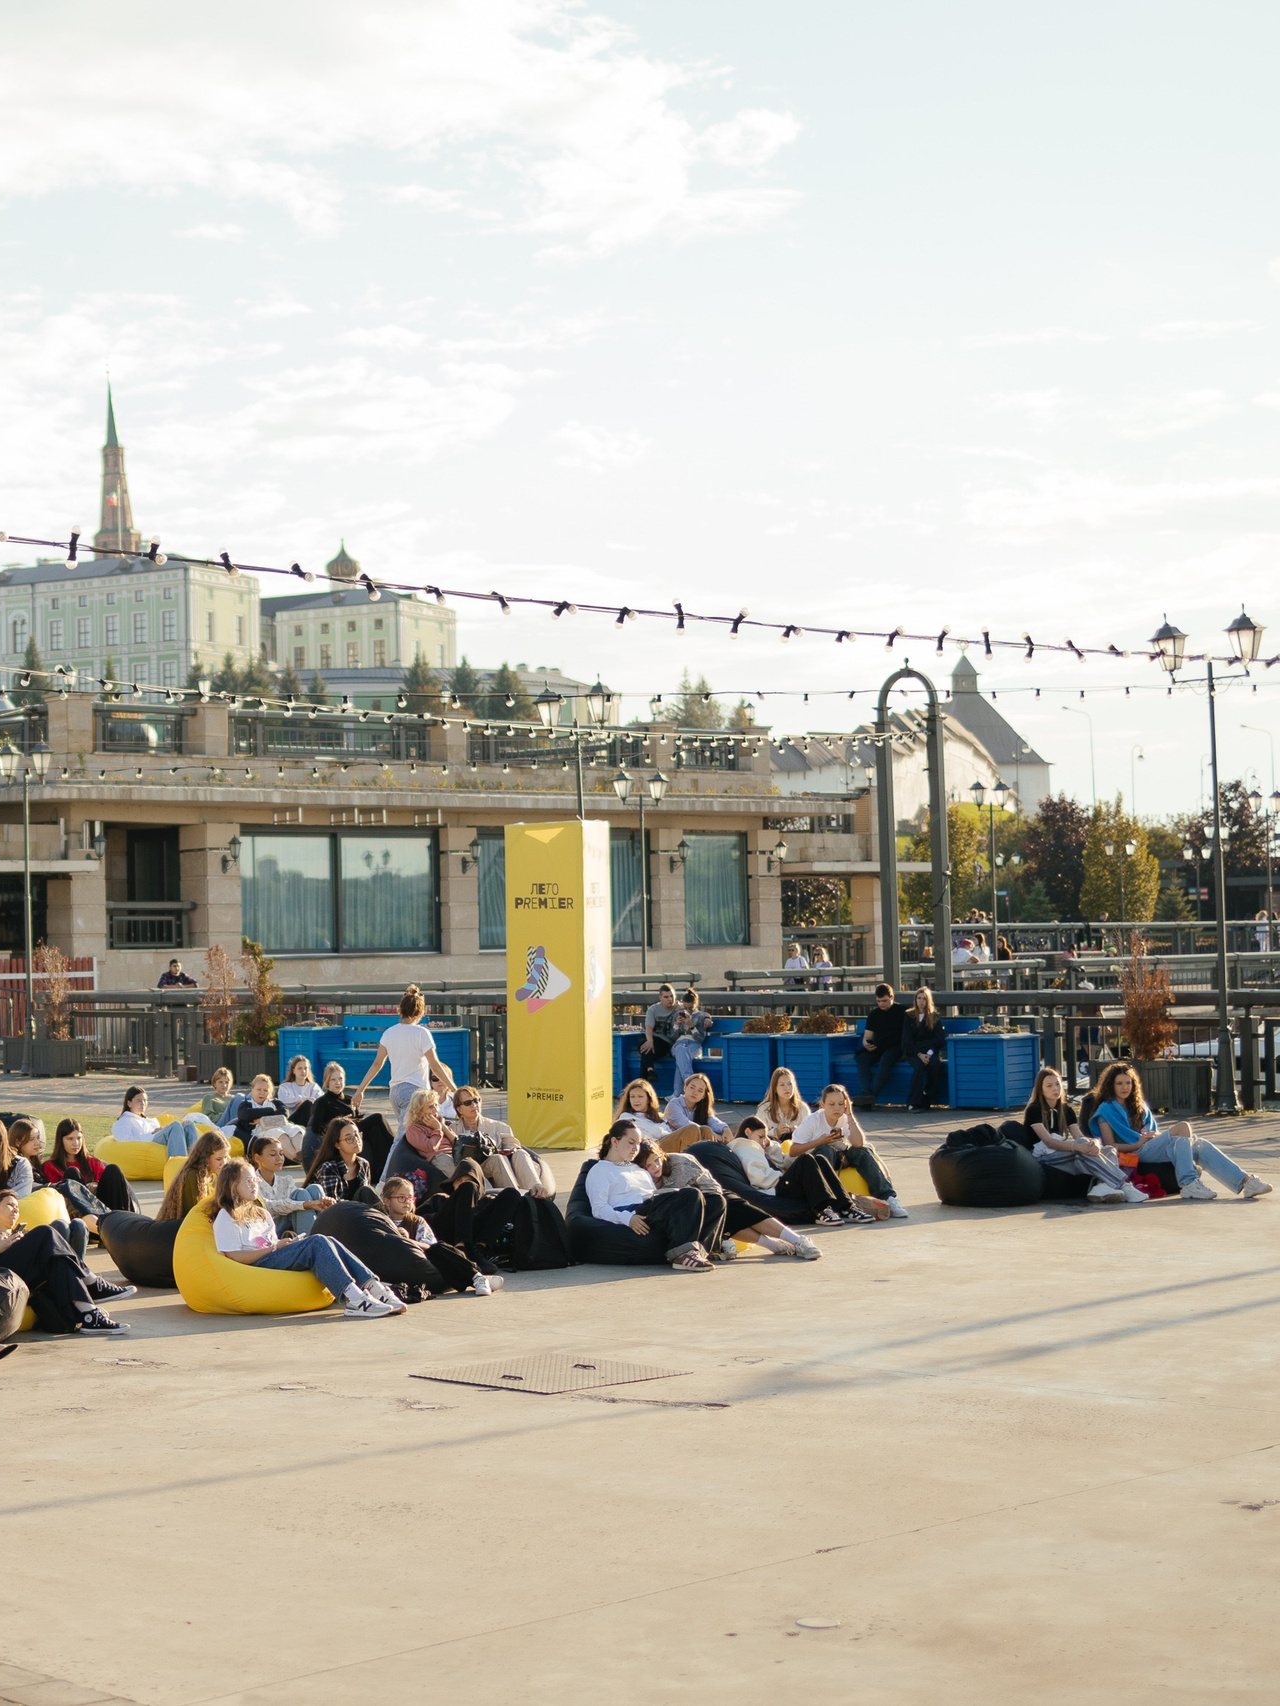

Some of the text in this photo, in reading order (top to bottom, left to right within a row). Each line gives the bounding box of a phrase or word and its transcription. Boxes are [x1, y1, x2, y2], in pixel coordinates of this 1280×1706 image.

[530, 883, 559, 895] ЛЕТО
[514, 897, 574, 909] PREMIER
[531, 1092, 564, 1102] PREMIER
